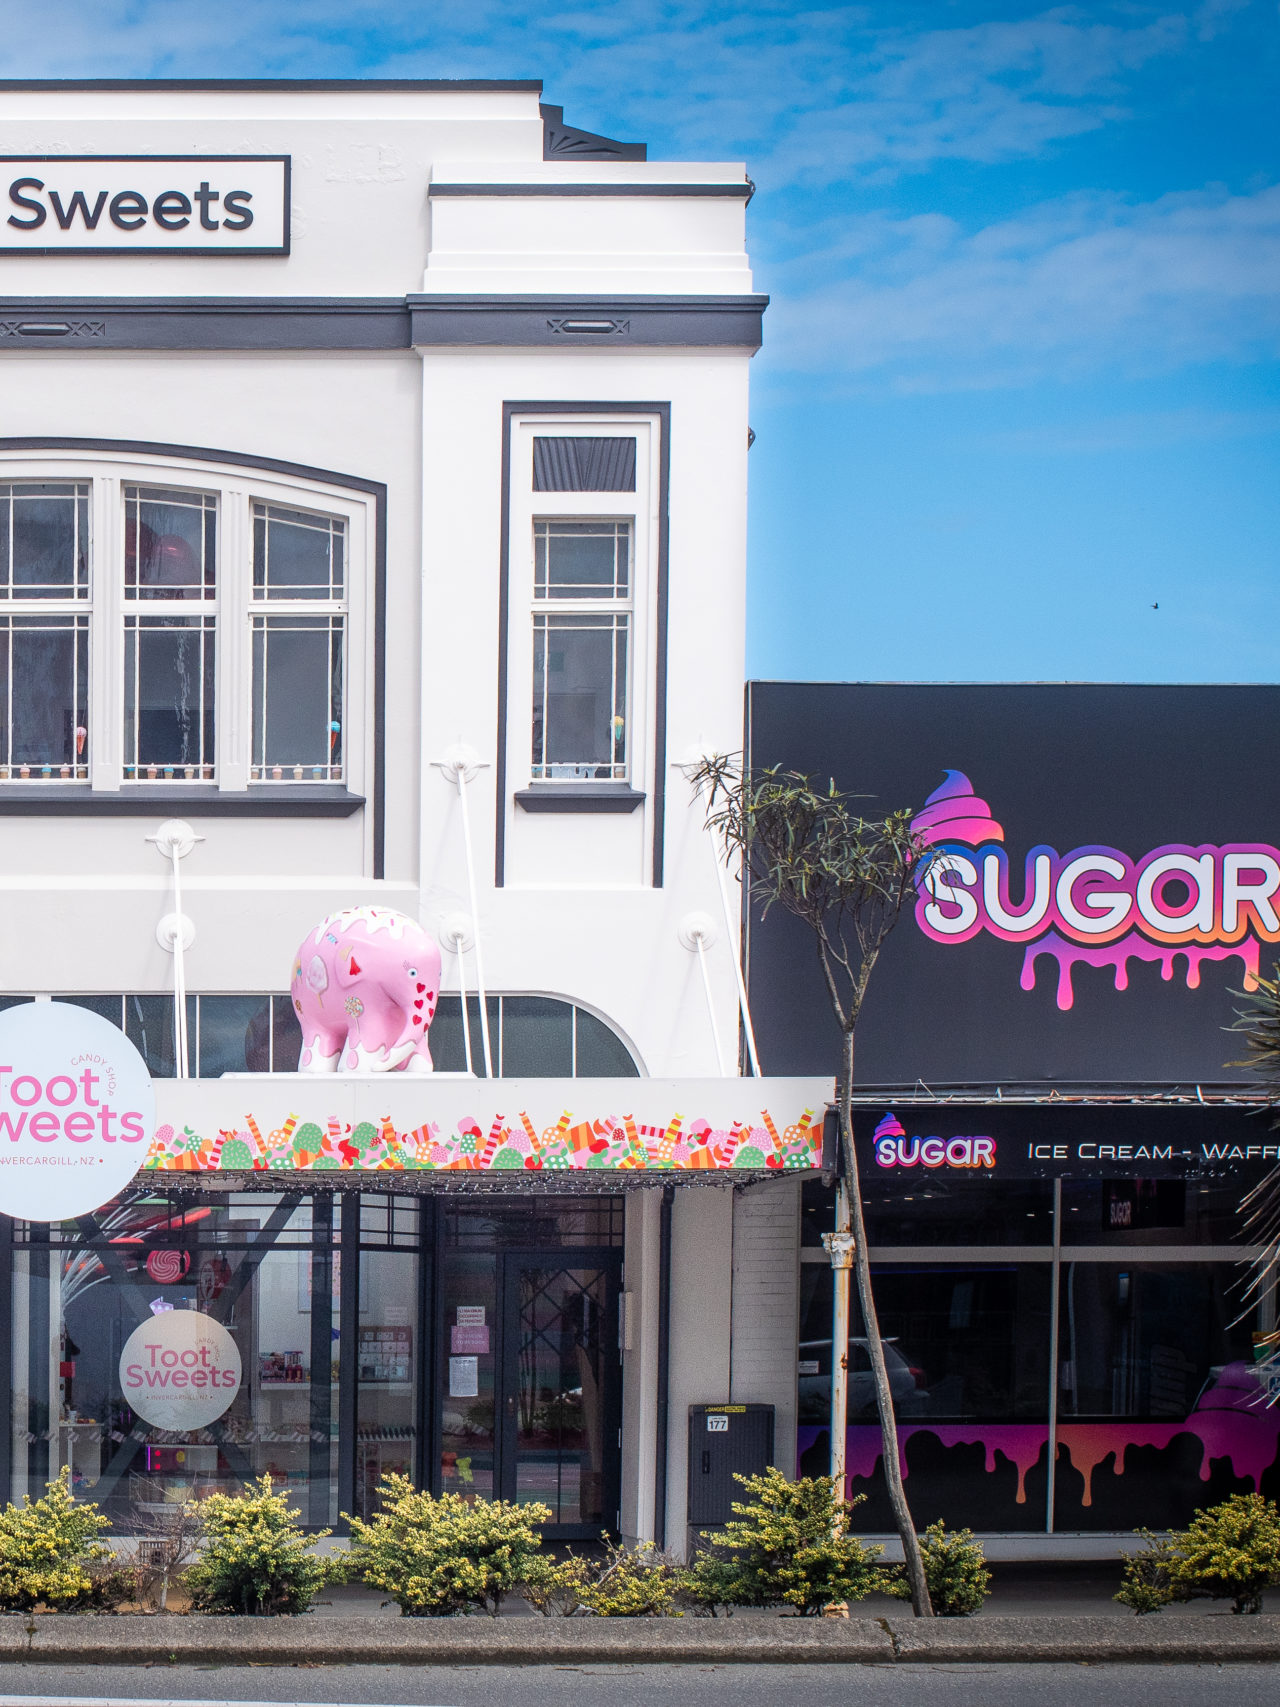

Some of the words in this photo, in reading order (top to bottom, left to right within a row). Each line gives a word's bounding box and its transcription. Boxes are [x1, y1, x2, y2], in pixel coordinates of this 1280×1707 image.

[6, 177, 254, 231] Sweets
[71, 1053, 107, 1066] CANDY
[105, 1066, 117, 1096] SHOP
[80, 1156, 95, 1165] NZ
[144, 1344, 211, 1368] Toot
[126, 1364, 236, 1388] Sweets
[709, 1420, 727, 1430] 177
